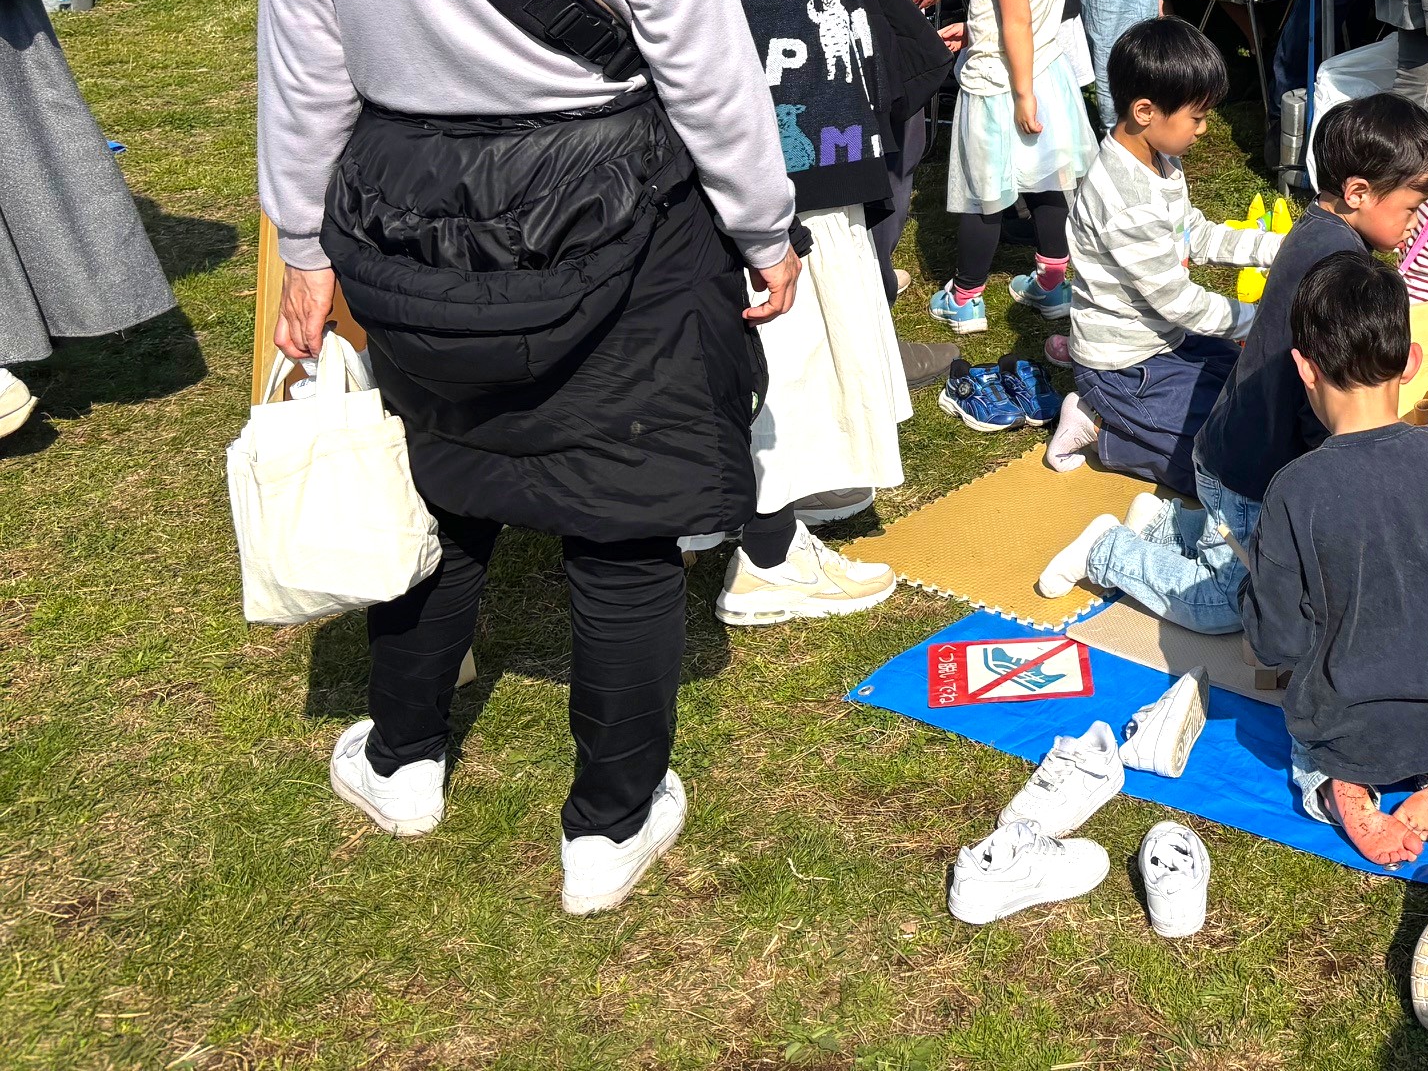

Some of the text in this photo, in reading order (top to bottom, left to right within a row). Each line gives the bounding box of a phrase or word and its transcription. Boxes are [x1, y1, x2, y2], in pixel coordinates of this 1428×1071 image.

[819, 124, 863, 167] M
[938, 644, 959, 705] くつ脱いでね
